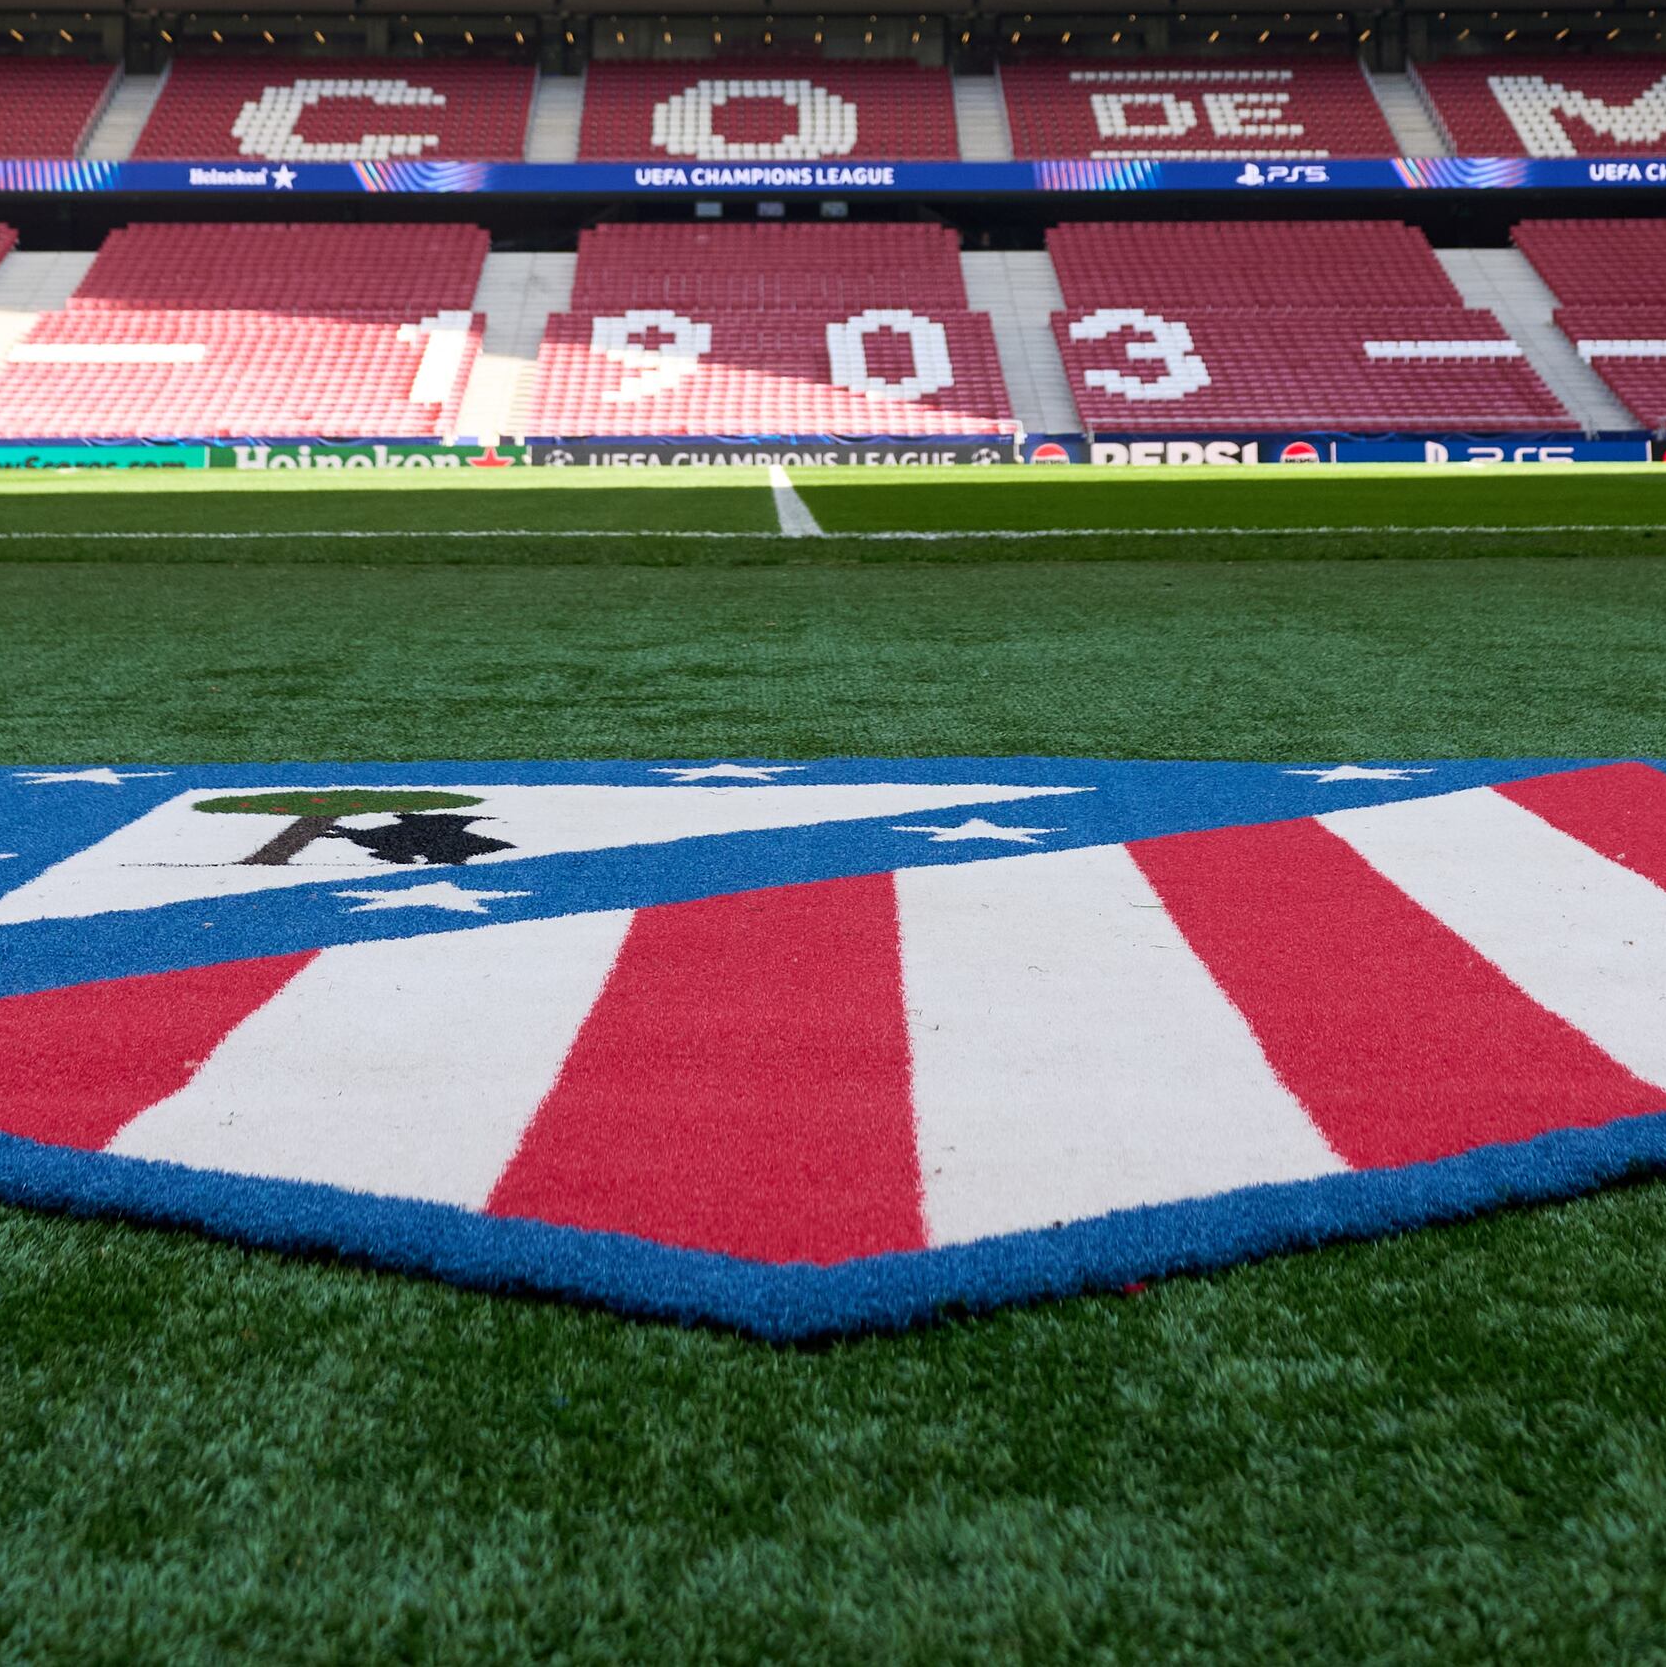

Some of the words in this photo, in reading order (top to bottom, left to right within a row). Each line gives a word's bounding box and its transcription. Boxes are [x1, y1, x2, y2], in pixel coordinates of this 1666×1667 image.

[1090, 93, 1304, 137] DE
[635, 167, 688, 186] UEFA
[691, 167, 813, 186] CHAMPIONS
[815, 167, 895, 186] LEAGUE
[1267, 165, 1326, 183] PS5
[1589, 163, 1642, 181] UEFA
[1091, 441, 1259, 464] PEPSI
